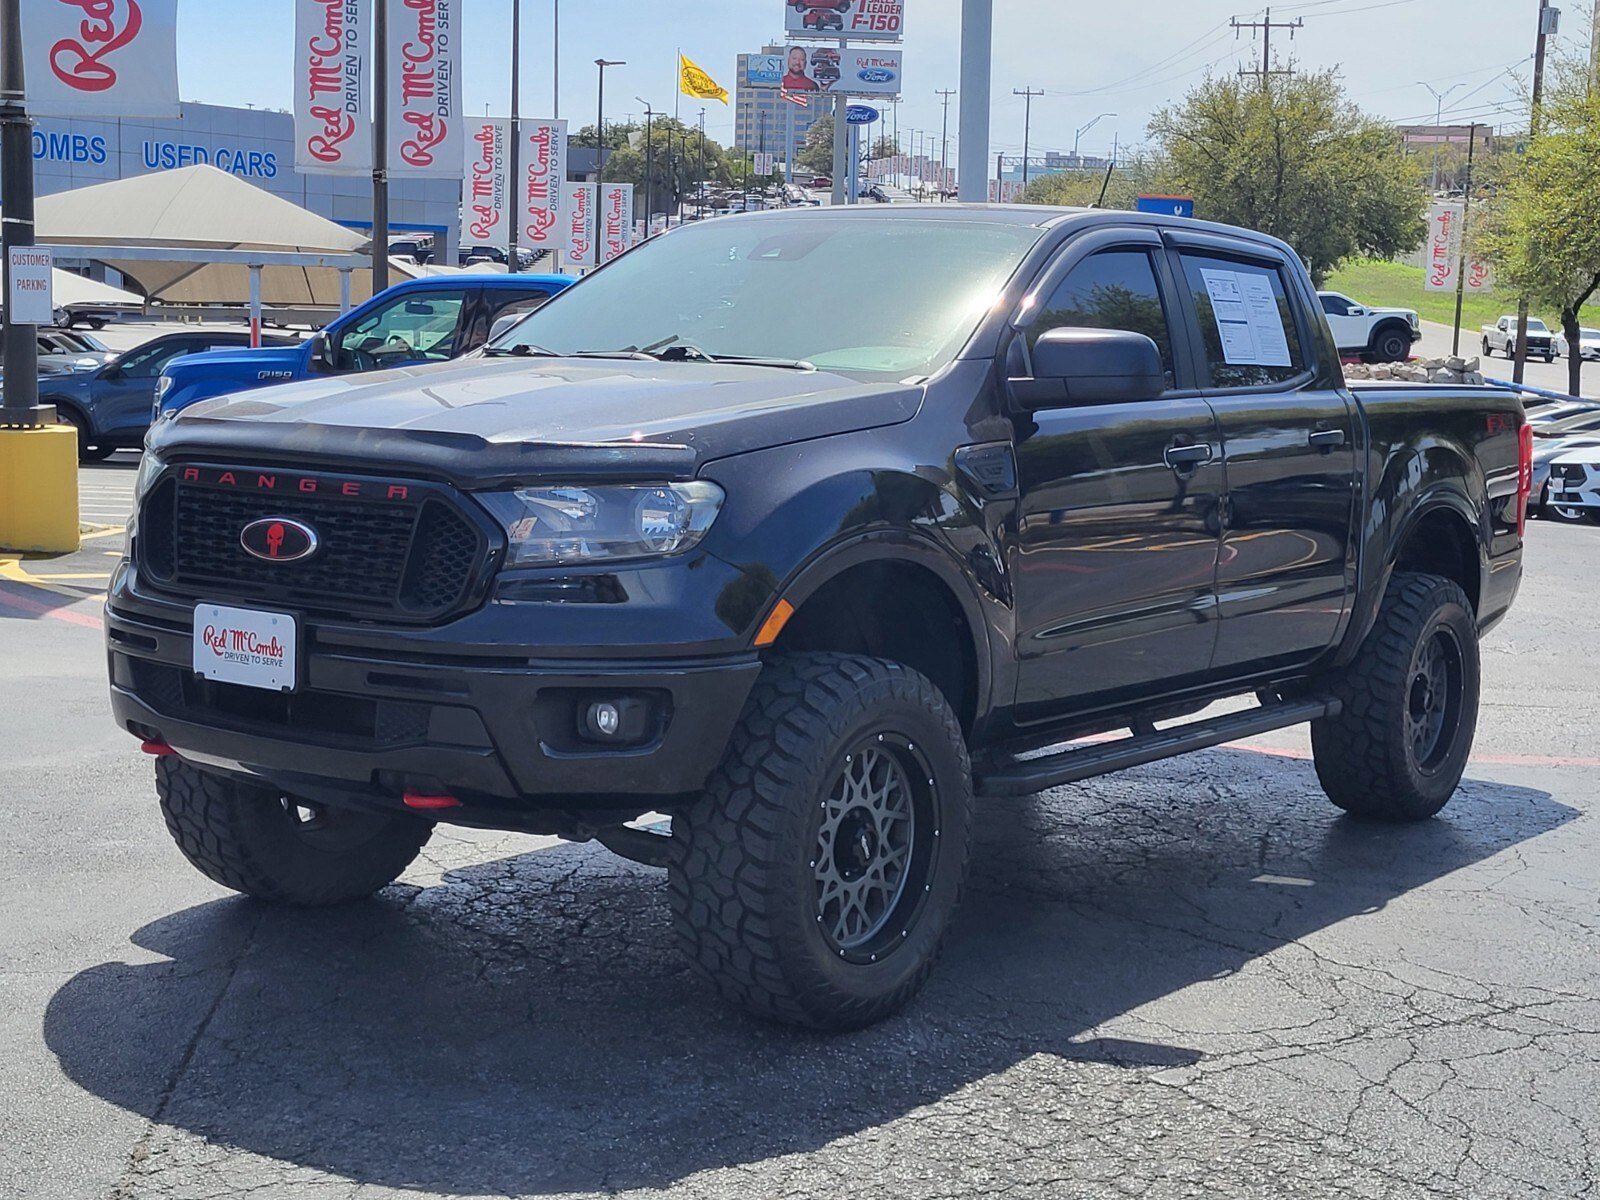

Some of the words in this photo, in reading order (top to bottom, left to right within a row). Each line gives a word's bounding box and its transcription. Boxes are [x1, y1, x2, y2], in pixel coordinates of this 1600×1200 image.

[438, 0, 449, 30] SER
[851, 13, 900, 31] F-150
[867, 4, 902, 14] LEADER
[309, 0, 343, 102] McCom
[346, 28, 358, 50] TO
[438, 34, 449, 55] TO
[346, 55, 358, 114] DRIVEN
[438, 60, 449, 117] DRIVEN
[864, 70, 888, 81] Ford
[308, 106, 355, 162] Red
[401, 111, 447, 167] Red
[495, 124, 503, 157] SERVE
[551, 126, 559, 157] SERVE
[144, 141, 208, 169] USED
[216, 148, 277, 177] CARS
[472, 124, 494, 201] McCombs
[495, 158, 503, 171] TO
[528, 126, 550, 204] McCombs
[551, 160, 559, 172] TO
[494, 173, 503, 210] DRIVEN
[550, 175, 559, 211] DRIVEN
[469, 204, 500, 239] Red
[526, 206, 556, 242] Red
[571, 187, 586, 236] McCombs
[607, 188, 621, 238] McCombs
[12, 254, 50, 266] CUSTOMER
[570, 238, 589, 261] Red
[17, 279, 47, 291] PARKING
[1430, 263, 1451, 286] Red
[184, 468, 408, 499] RANGER
[203, 624, 228, 656] Red
[229, 629, 283, 658] McCombs
[224, 651, 250, 663] DRIVEN
[251, 654, 260, 664] TO
[262, 657, 284, 667] SERVE
